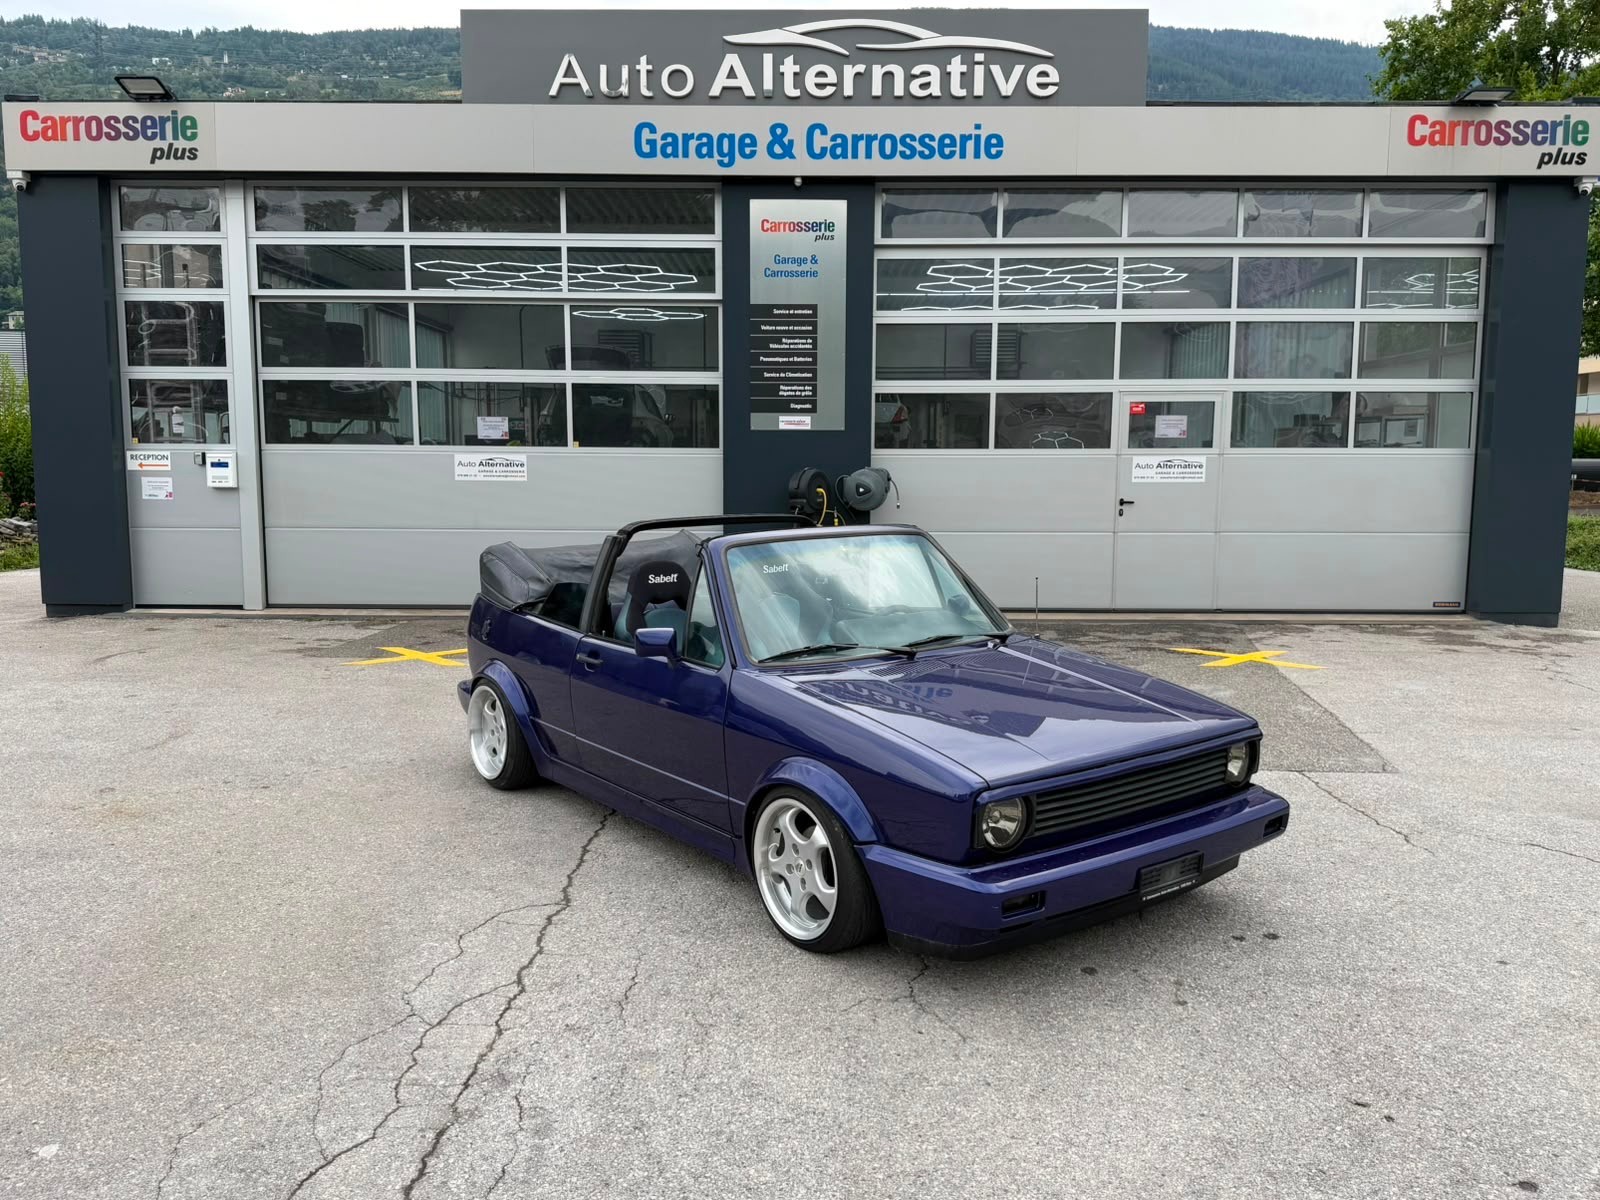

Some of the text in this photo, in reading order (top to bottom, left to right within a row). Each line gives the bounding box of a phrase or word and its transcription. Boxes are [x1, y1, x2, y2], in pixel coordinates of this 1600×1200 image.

[548, 52, 1061, 98] Auto Alternative
[19, 109, 199, 142] Carrosserie
[1407, 114, 1590, 147] Carrosserie
[633, 121, 1005, 168] Garage & Carrosserie
[149, 142, 199, 165] plus
[1536, 147, 1588, 170] plus
[760, 218, 836, 233] Carrosserie
[814, 232, 836, 243] plus
[773, 253, 819, 267] Garage &
[763, 267, 819, 278] Carrosserie
[129, 453, 169, 461] RECEPTION
[456, 460, 477, 468] Auto
[1134, 462, 1204, 470] Auto Alternative
[763, 563, 789, 575] Sabelt
[647, 573, 679, 585] Sabelt
